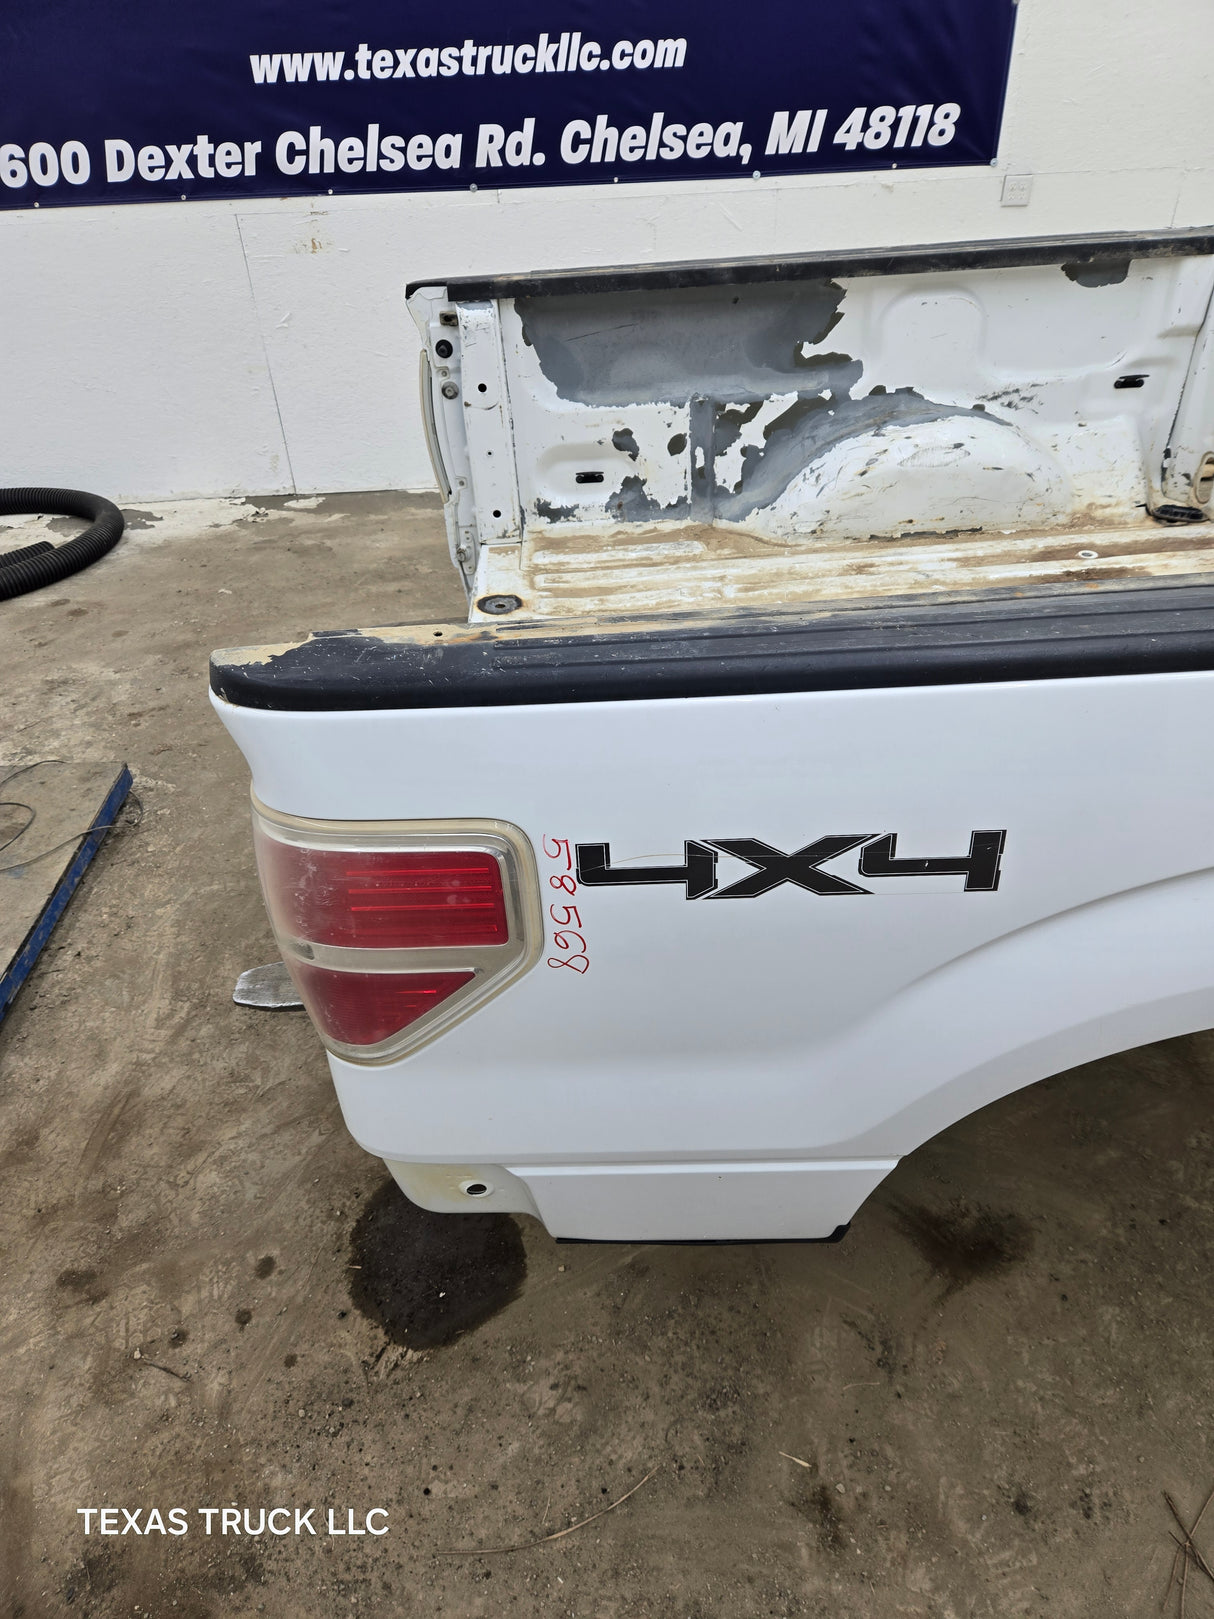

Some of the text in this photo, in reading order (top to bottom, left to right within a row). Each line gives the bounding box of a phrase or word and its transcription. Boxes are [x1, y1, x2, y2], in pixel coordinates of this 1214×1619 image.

[250, 32, 687, 84] www.texastruckllc.com
[0, 103, 961, 188] 600 Dexter Chelsea Rd. Chelsea, MI 48118
[542, 833, 590, 975] 58568
